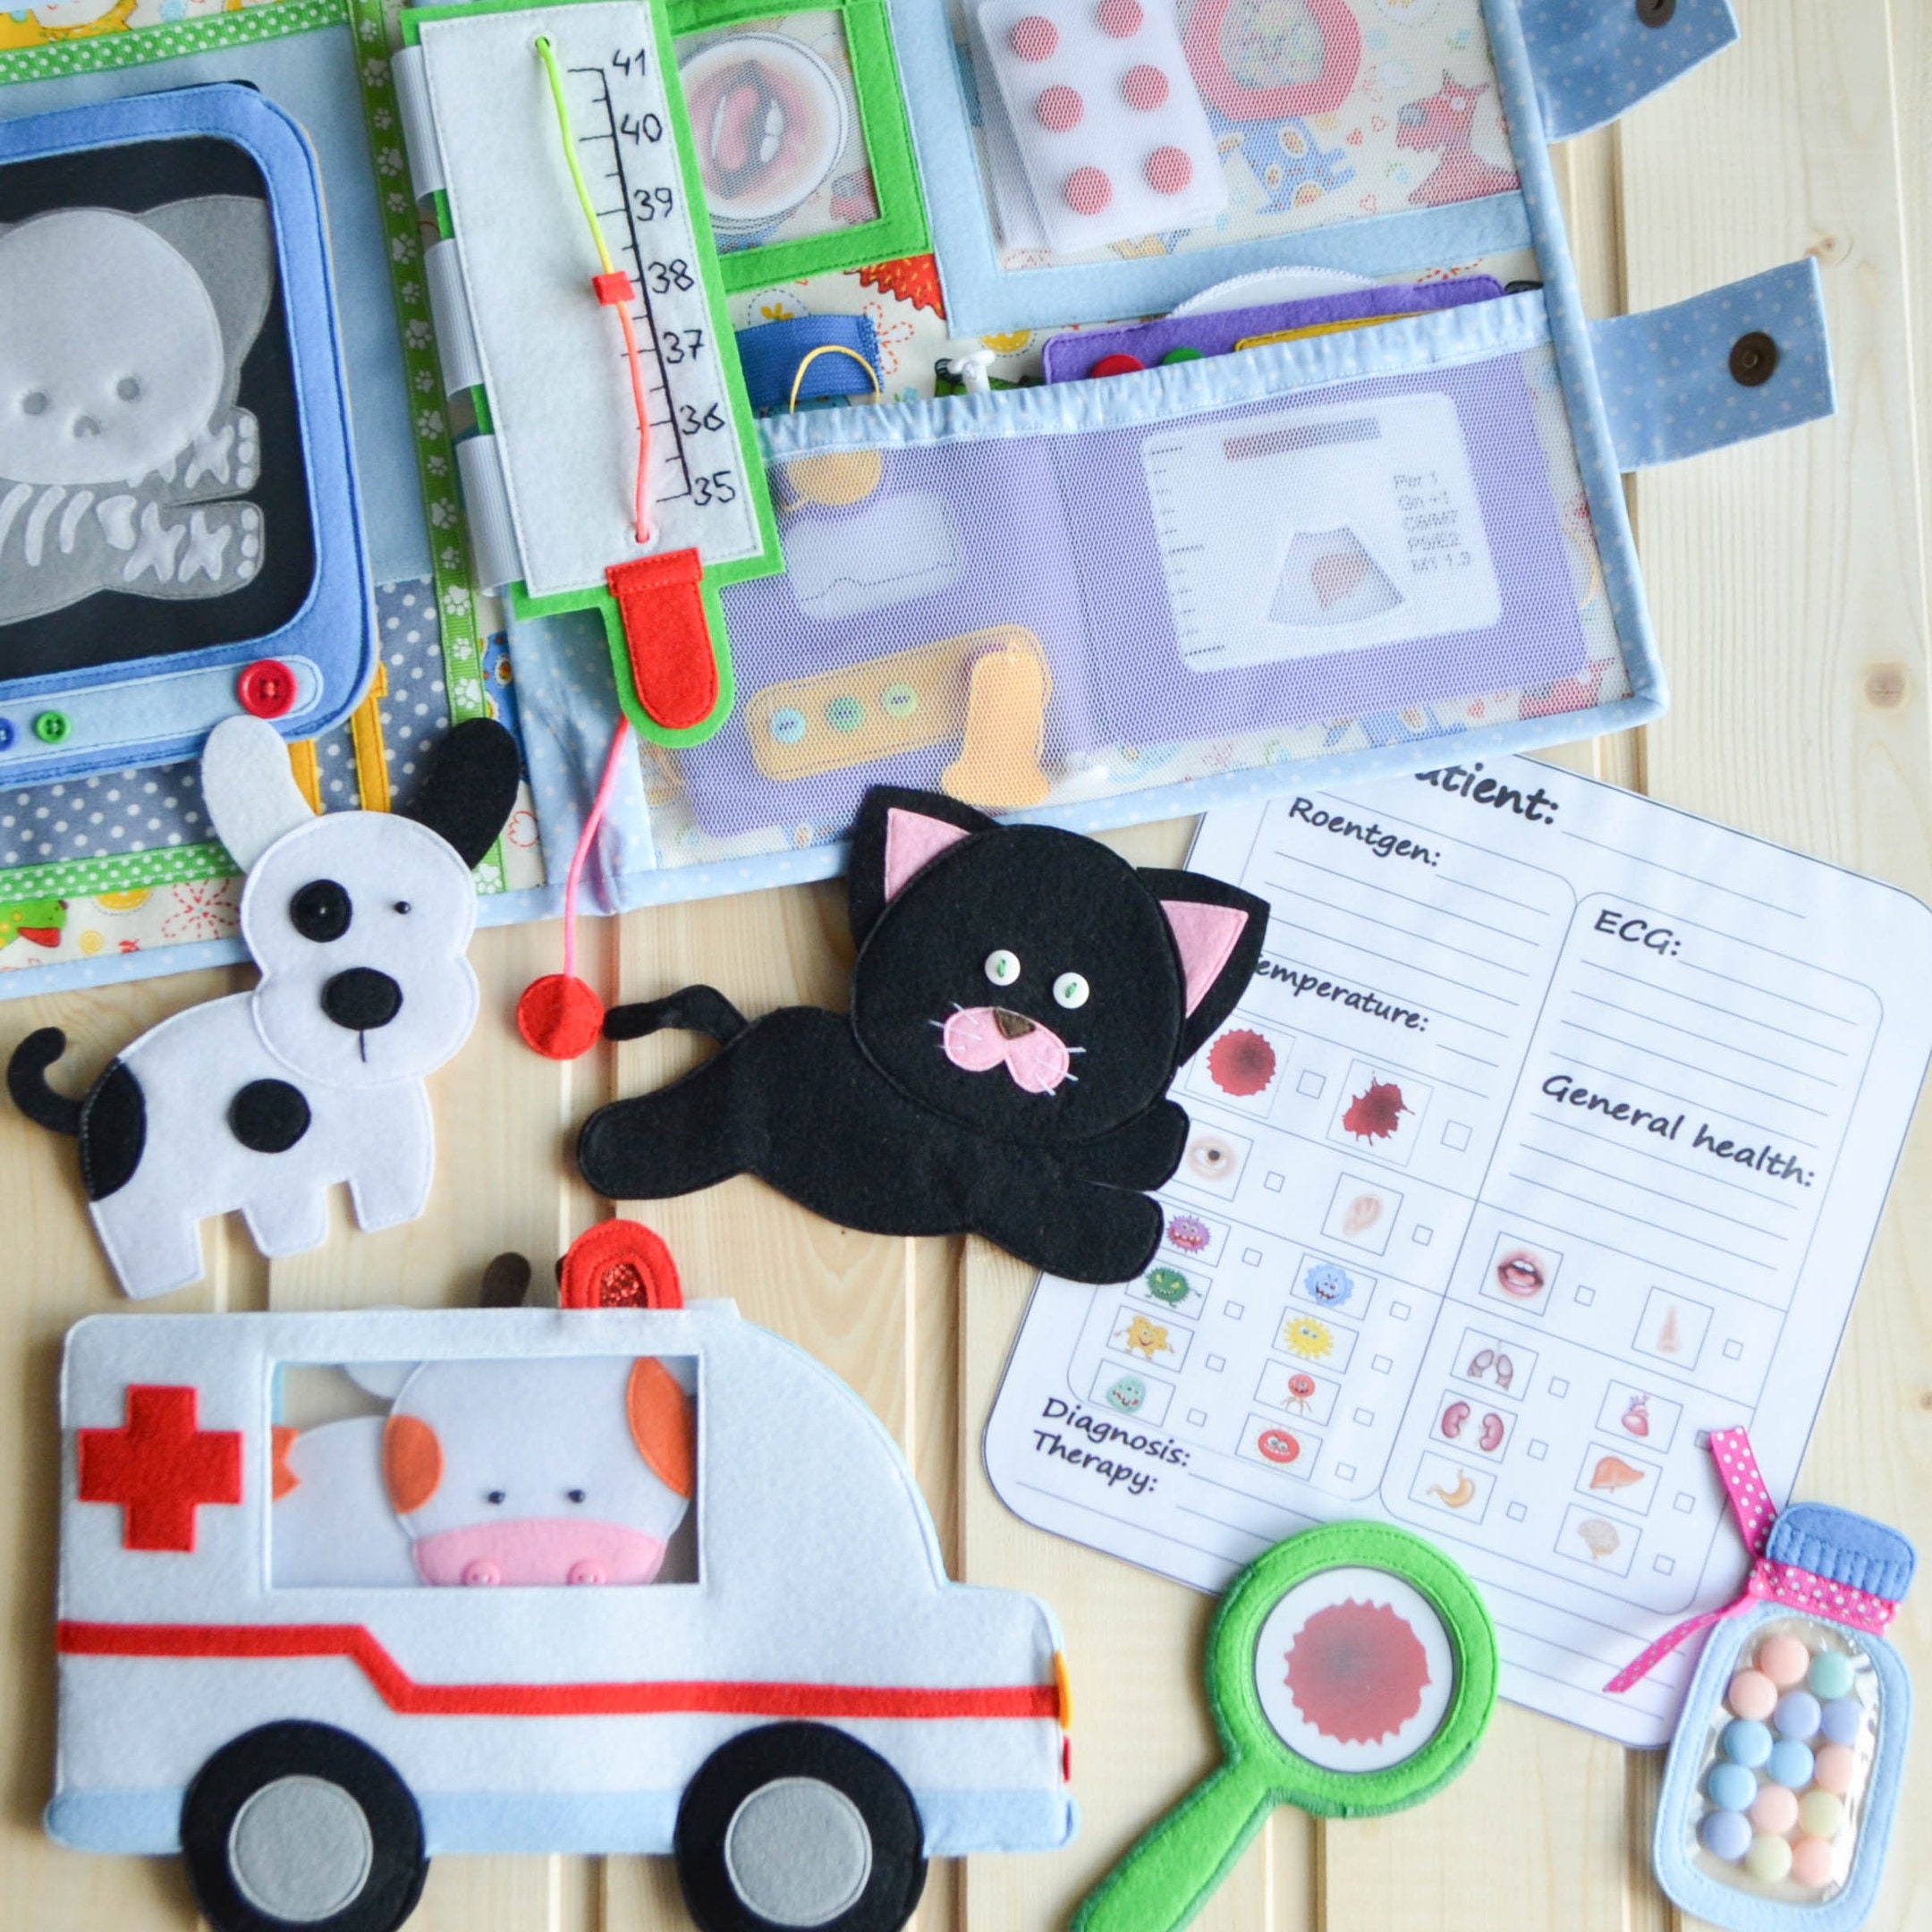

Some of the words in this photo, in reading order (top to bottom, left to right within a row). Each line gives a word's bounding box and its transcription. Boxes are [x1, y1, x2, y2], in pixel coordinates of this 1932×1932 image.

[612, 49, 646, 77] 41
[621, 113, 662, 145] 40
[635, 187, 673, 221] 39
[648, 258, 694, 293] 38
[663, 328, 703, 364] 37
[680, 402, 725, 435] 36
[694, 470, 735, 507] 35
[1288, 797, 1440, 867] Roentgen:
[1594, 909, 1681, 956] ECG:
[1255, 953, 1429, 1032] emperature:
[1541, 1074, 1685, 1141] General
[1691, 1123, 1815, 1188] health:
[1042, 1397, 1191, 1467] Diagnosis:
[1033, 1429, 1158, 1495] Therapy:
